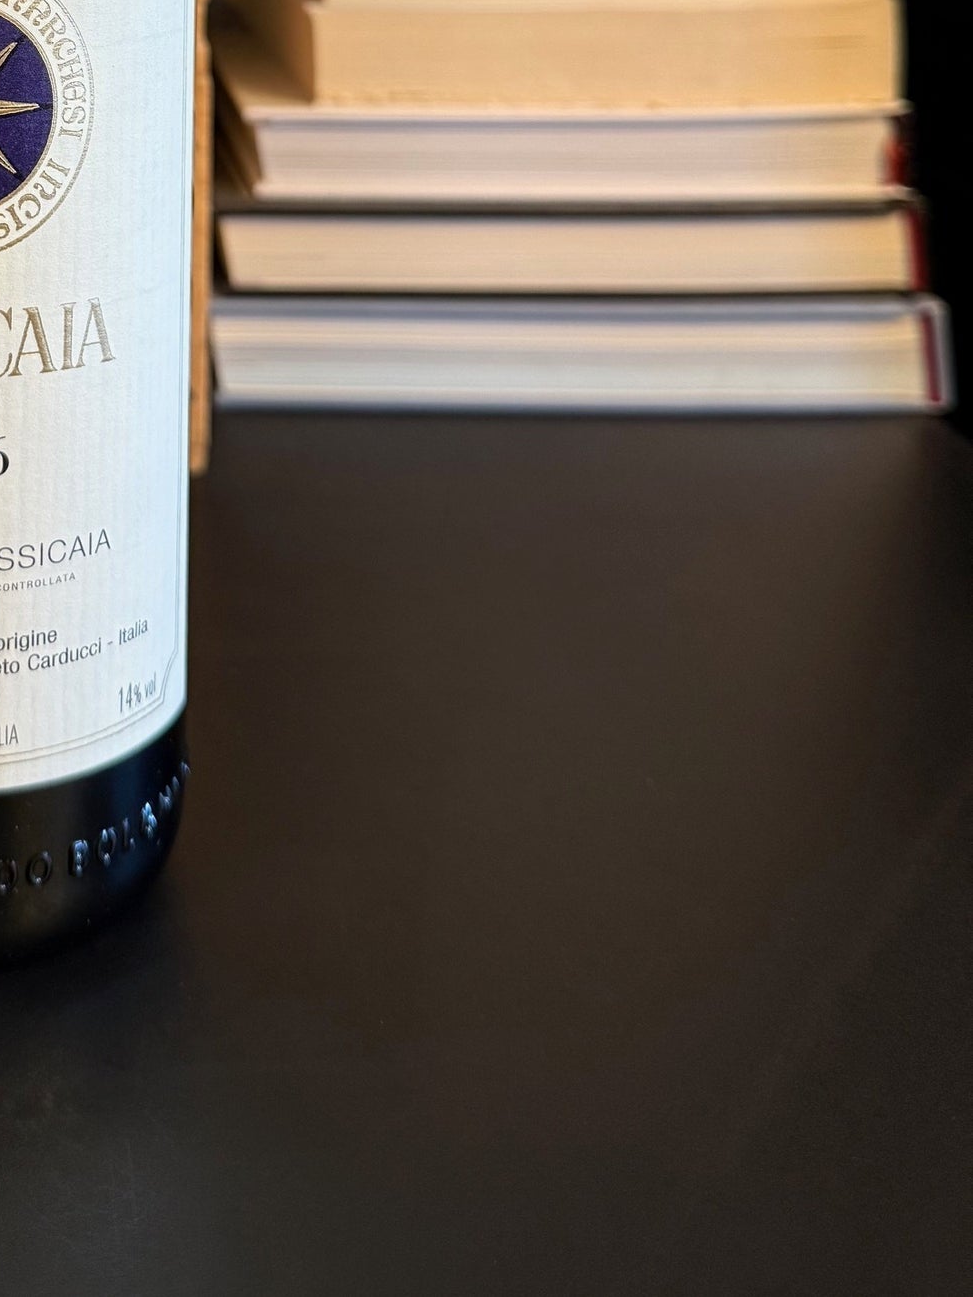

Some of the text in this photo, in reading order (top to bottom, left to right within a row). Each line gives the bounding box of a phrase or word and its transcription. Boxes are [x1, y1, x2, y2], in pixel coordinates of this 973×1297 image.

[27, 637, 102, 671] Carducci
[118, 619, 149, 646] Italia
[118, 671, 157, 714] 14% vol
